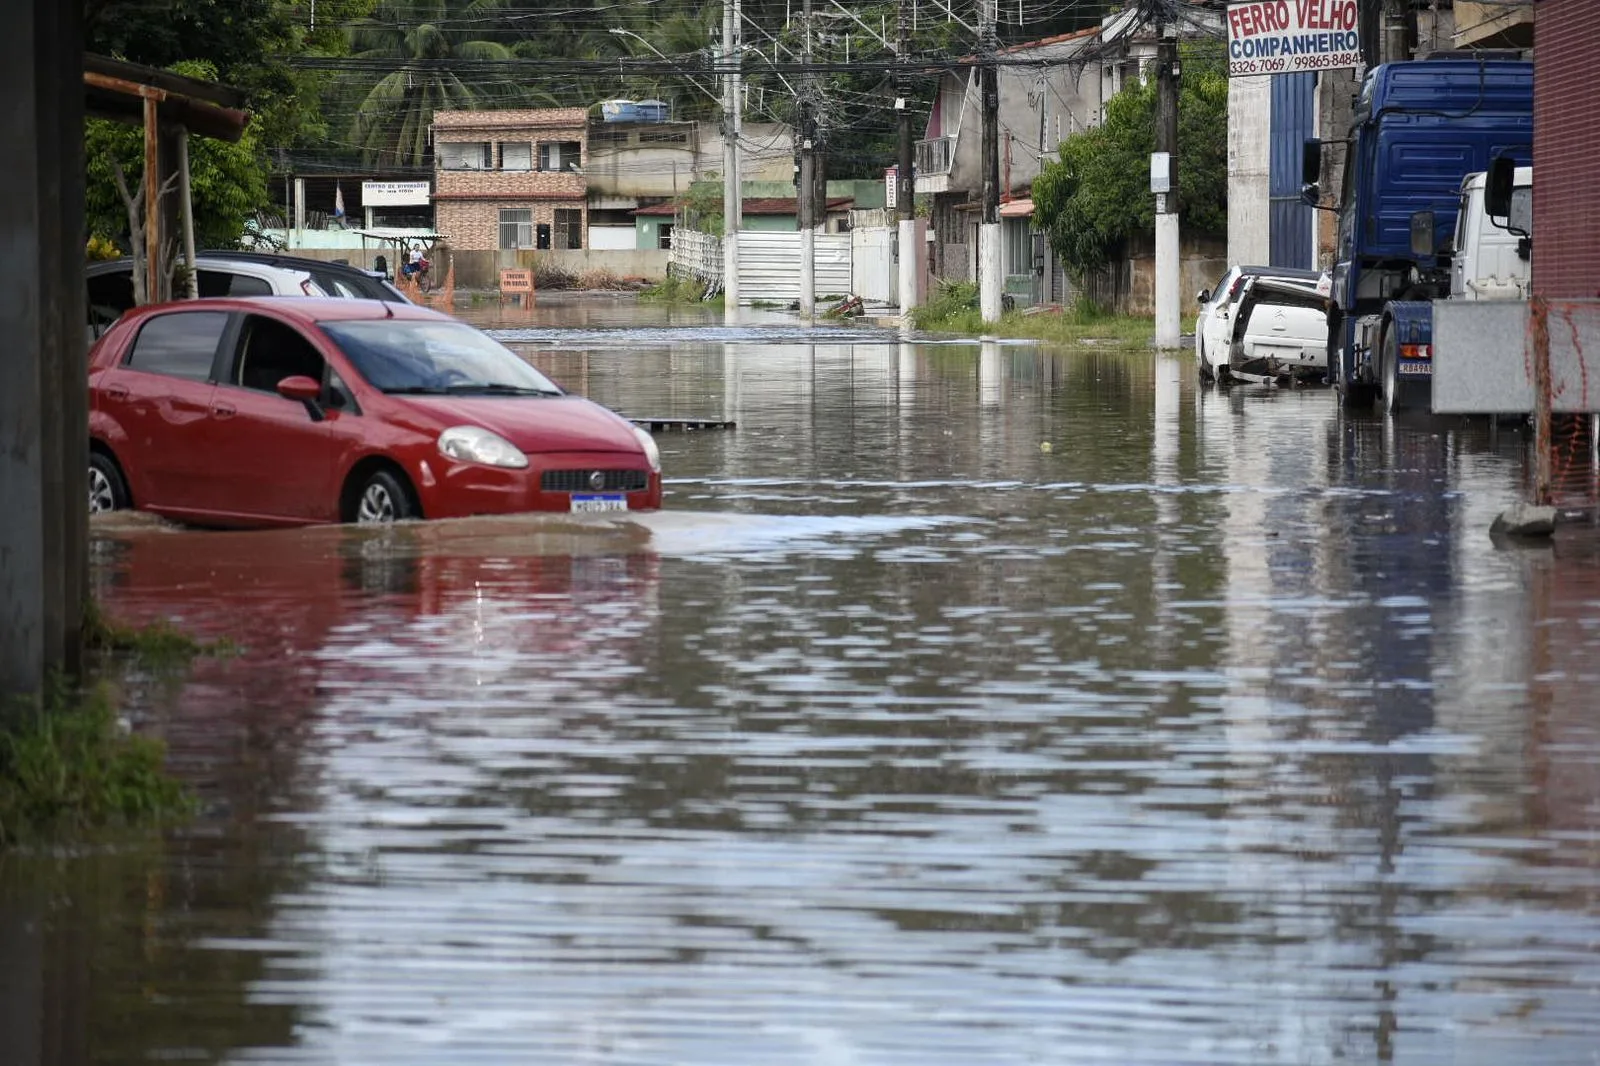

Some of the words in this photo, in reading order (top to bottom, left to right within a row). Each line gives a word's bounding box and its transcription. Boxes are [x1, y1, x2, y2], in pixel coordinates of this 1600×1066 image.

[1228, 1, 1289, 39] FERRO
[1295, 0, 1357, 31] VELHO
[1230, 31, 1358, 59] COMPANHEIRO
